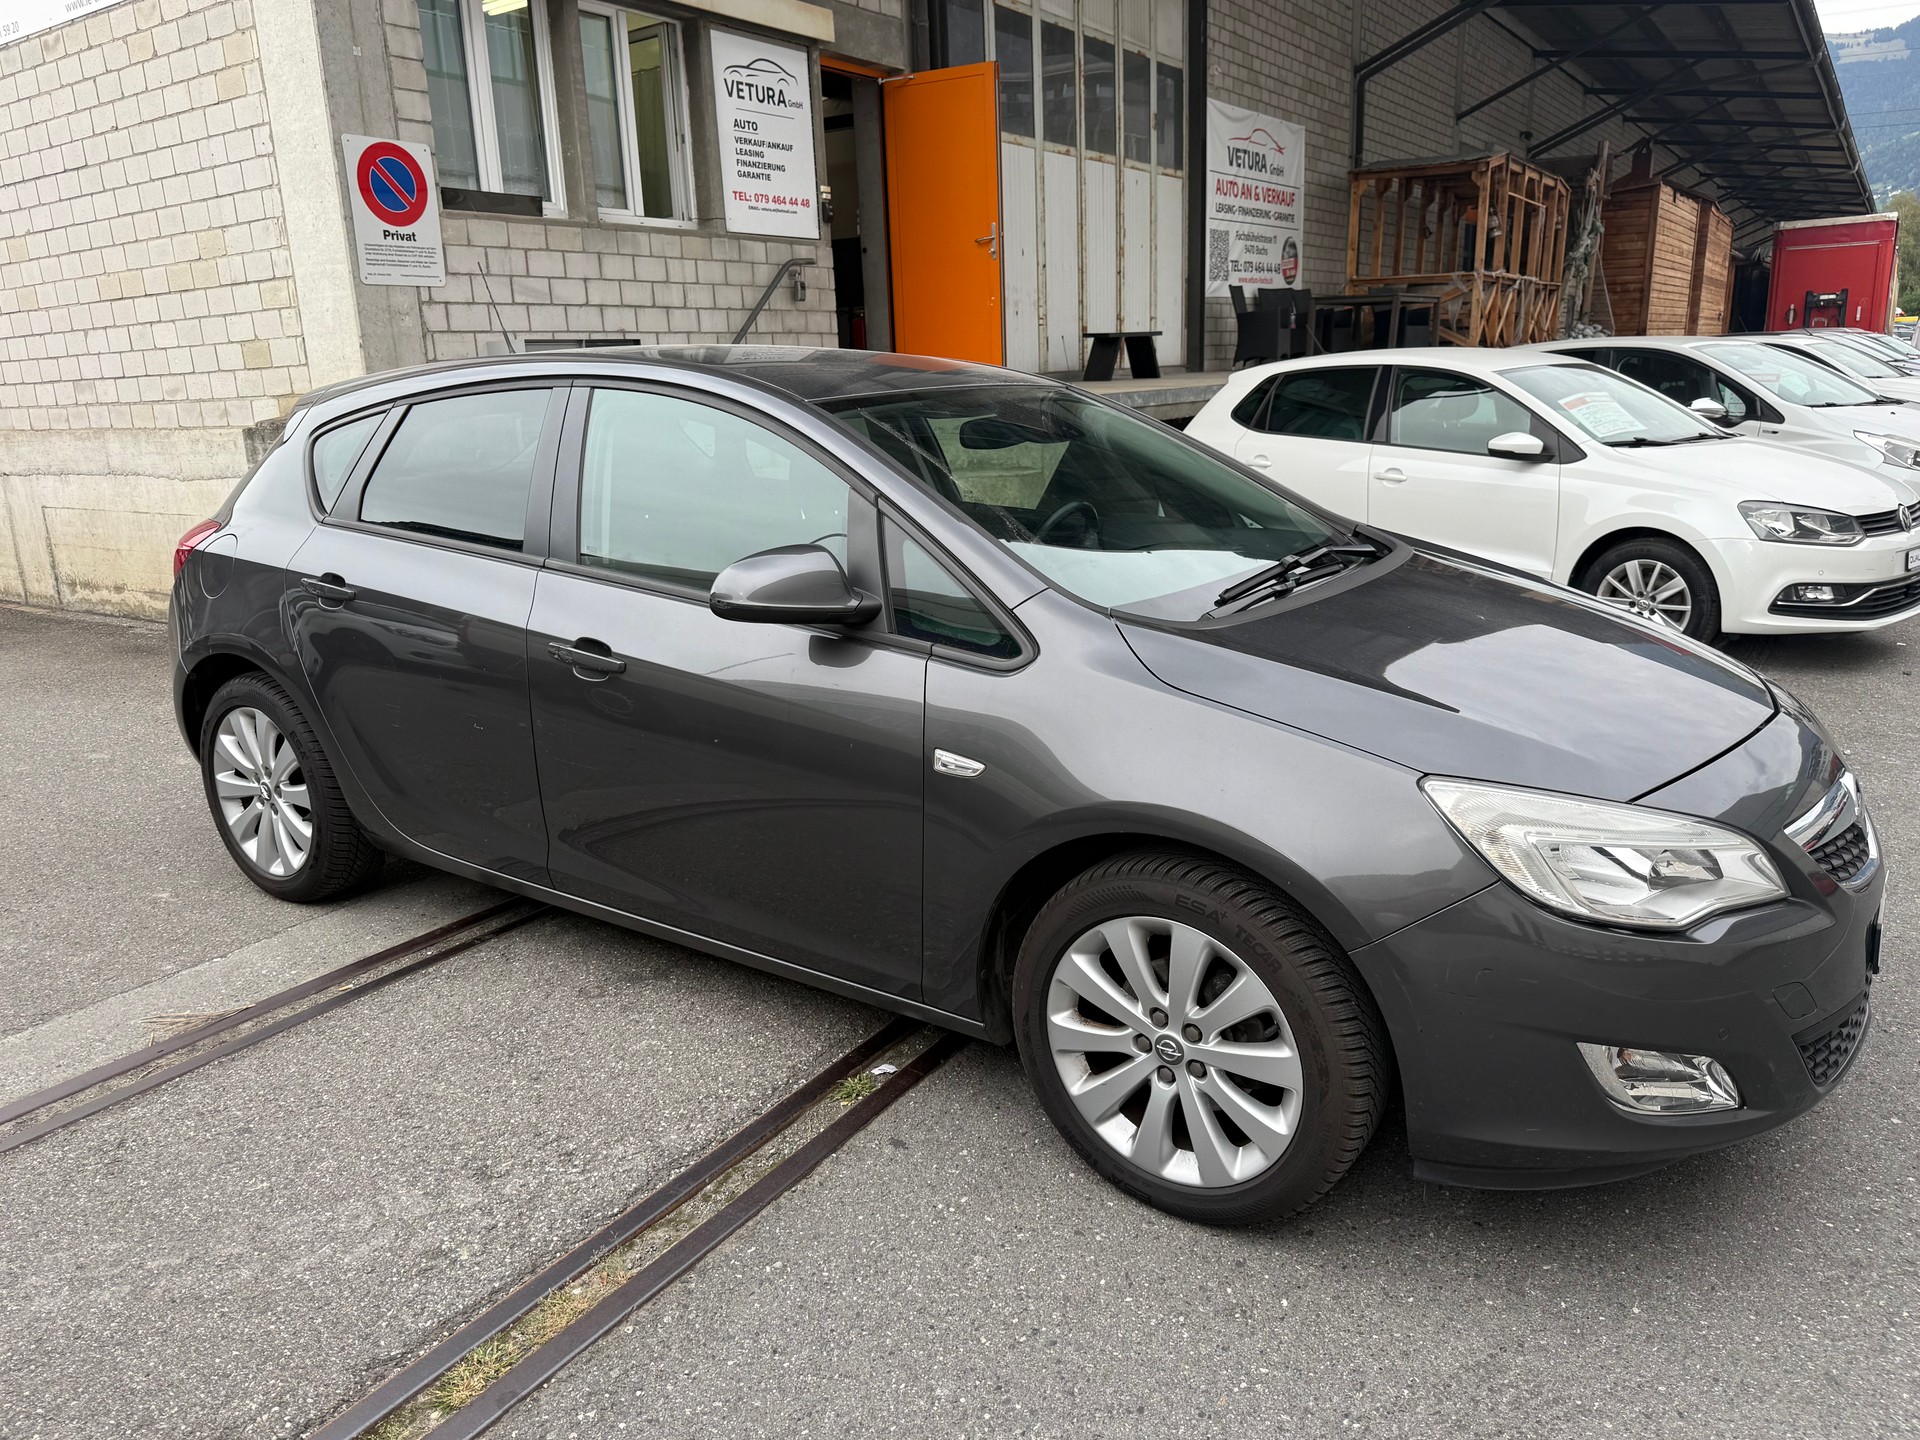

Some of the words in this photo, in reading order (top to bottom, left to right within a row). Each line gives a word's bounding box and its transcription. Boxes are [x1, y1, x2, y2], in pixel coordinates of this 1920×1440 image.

[723, 78, 787, 108] VETURA
[788, 99, 804, 109] GmbH
[733, 118, 758, 131] AUTO
[735, 147, 765, 159] LEASING
[736, 159, 786, 172] FINANZIERUNG
[1227, 145, 1267, 173] VETURA
[1269, 163, 1284, 177] GmbH
[737, 170, 771, 181] GARANTIE
[732, 190, 752, 202] TEL:
[754, 193, 769, 204] 079
[772, 195, 787, 206] 464
[788, 197, 799, 207] 44
[800, 199, 811, 208] 48
[1215, 178, 1239, 198] AUTO
[1240, 183, 1252, 201] AN
[1254, 185, 1260, 201] &
[1261, 186, 1295, 207] VERKAUF
[382, 229, 417, 242] Privat
[1230, 260, 1242, 272] TEL:
[1243, 260, 1253, 273] 079
[1254, 261, 1265, 274] 464
[1266, 262, 1273, 274] 44
[1274, 263, 1281, 275] 48
[1234, 924, 1283, 975] TECAR
